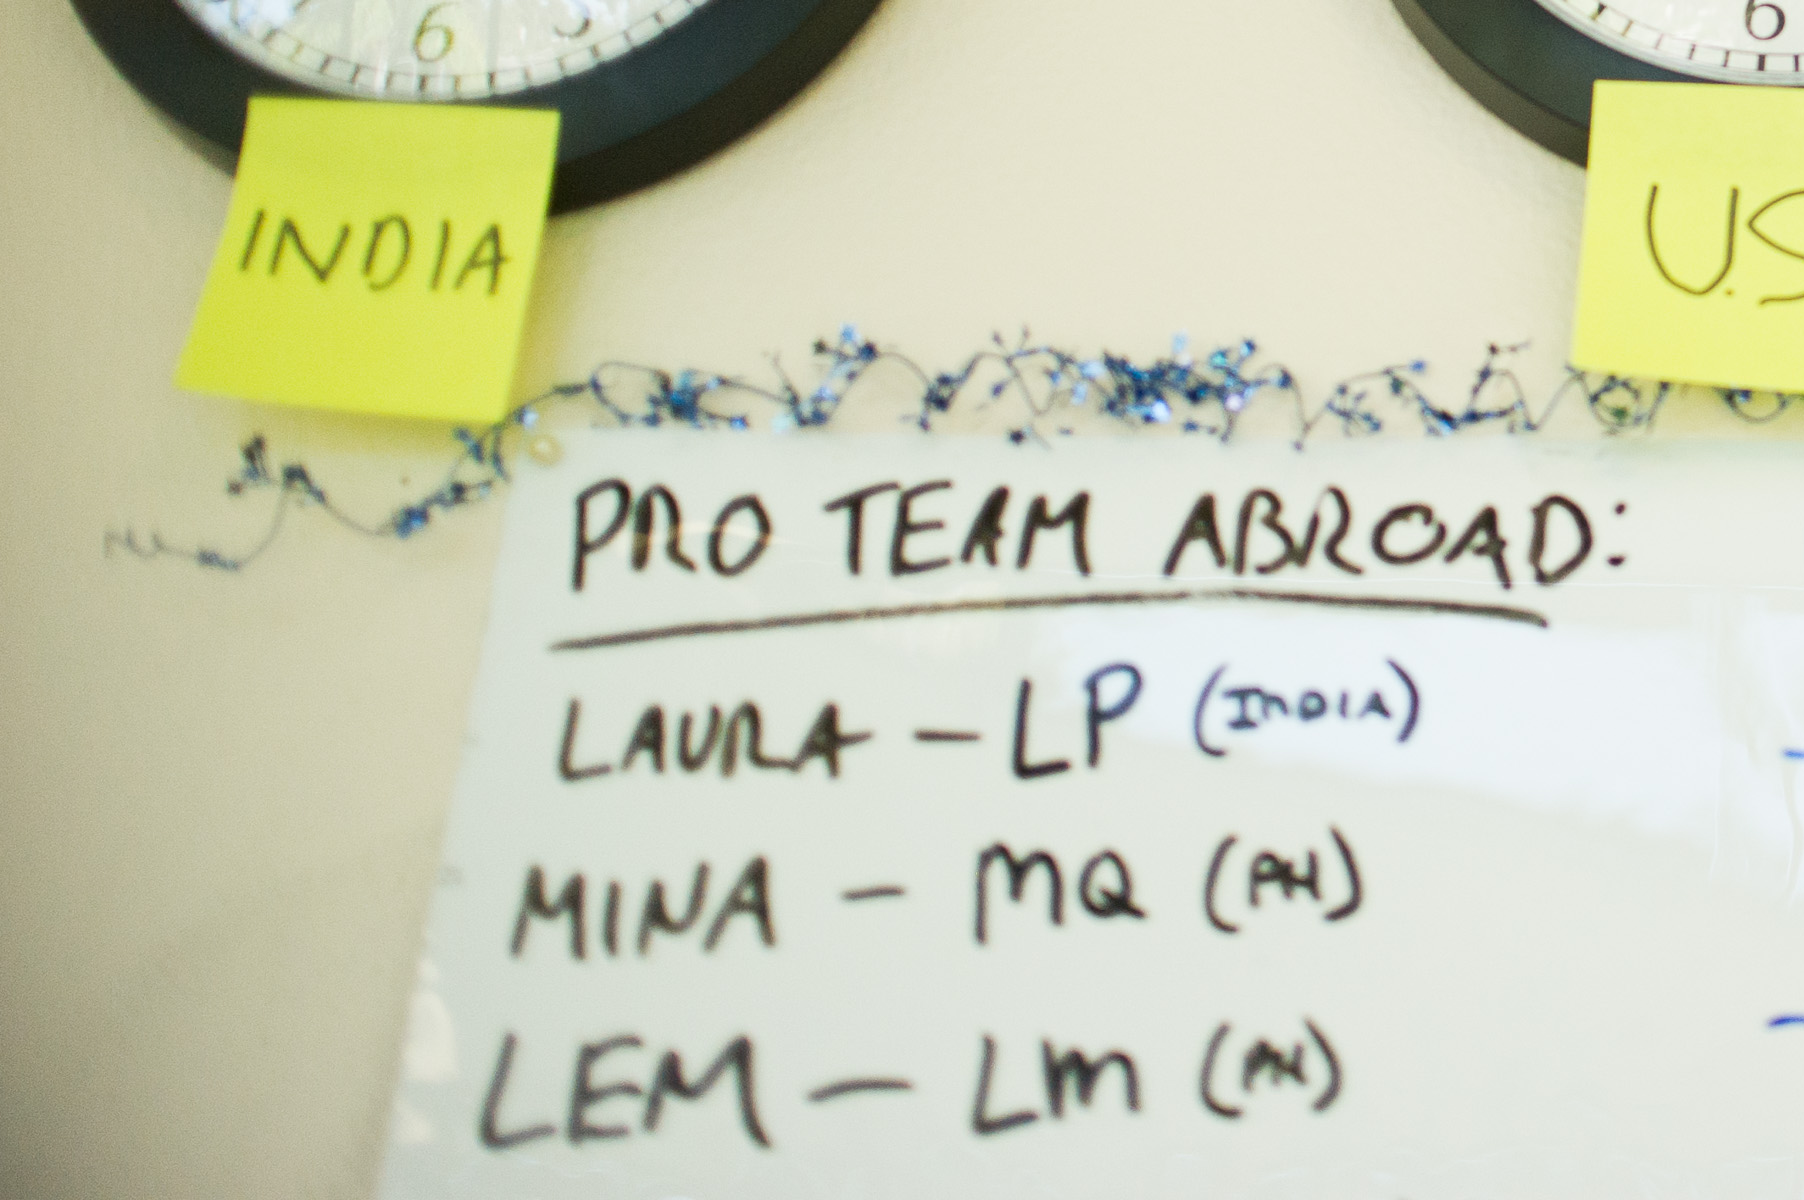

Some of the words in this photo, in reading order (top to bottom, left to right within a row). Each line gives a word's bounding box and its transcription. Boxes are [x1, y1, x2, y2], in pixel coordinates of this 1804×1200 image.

[412, 7, 455, 62] 6
[238, 207, 512, 296] INDIA
[571, 478, 773, 592] PRO
[824, 479, 1091, 578] TEAM
[1161, 486, 1630, 590] ABROAD:
[558, 699, 875, 781] LAURA
[1012, 661, 1144, 780] LP
[509, 855, 778, 961] MINA
[478, 1031, 774, 1150] LEM
